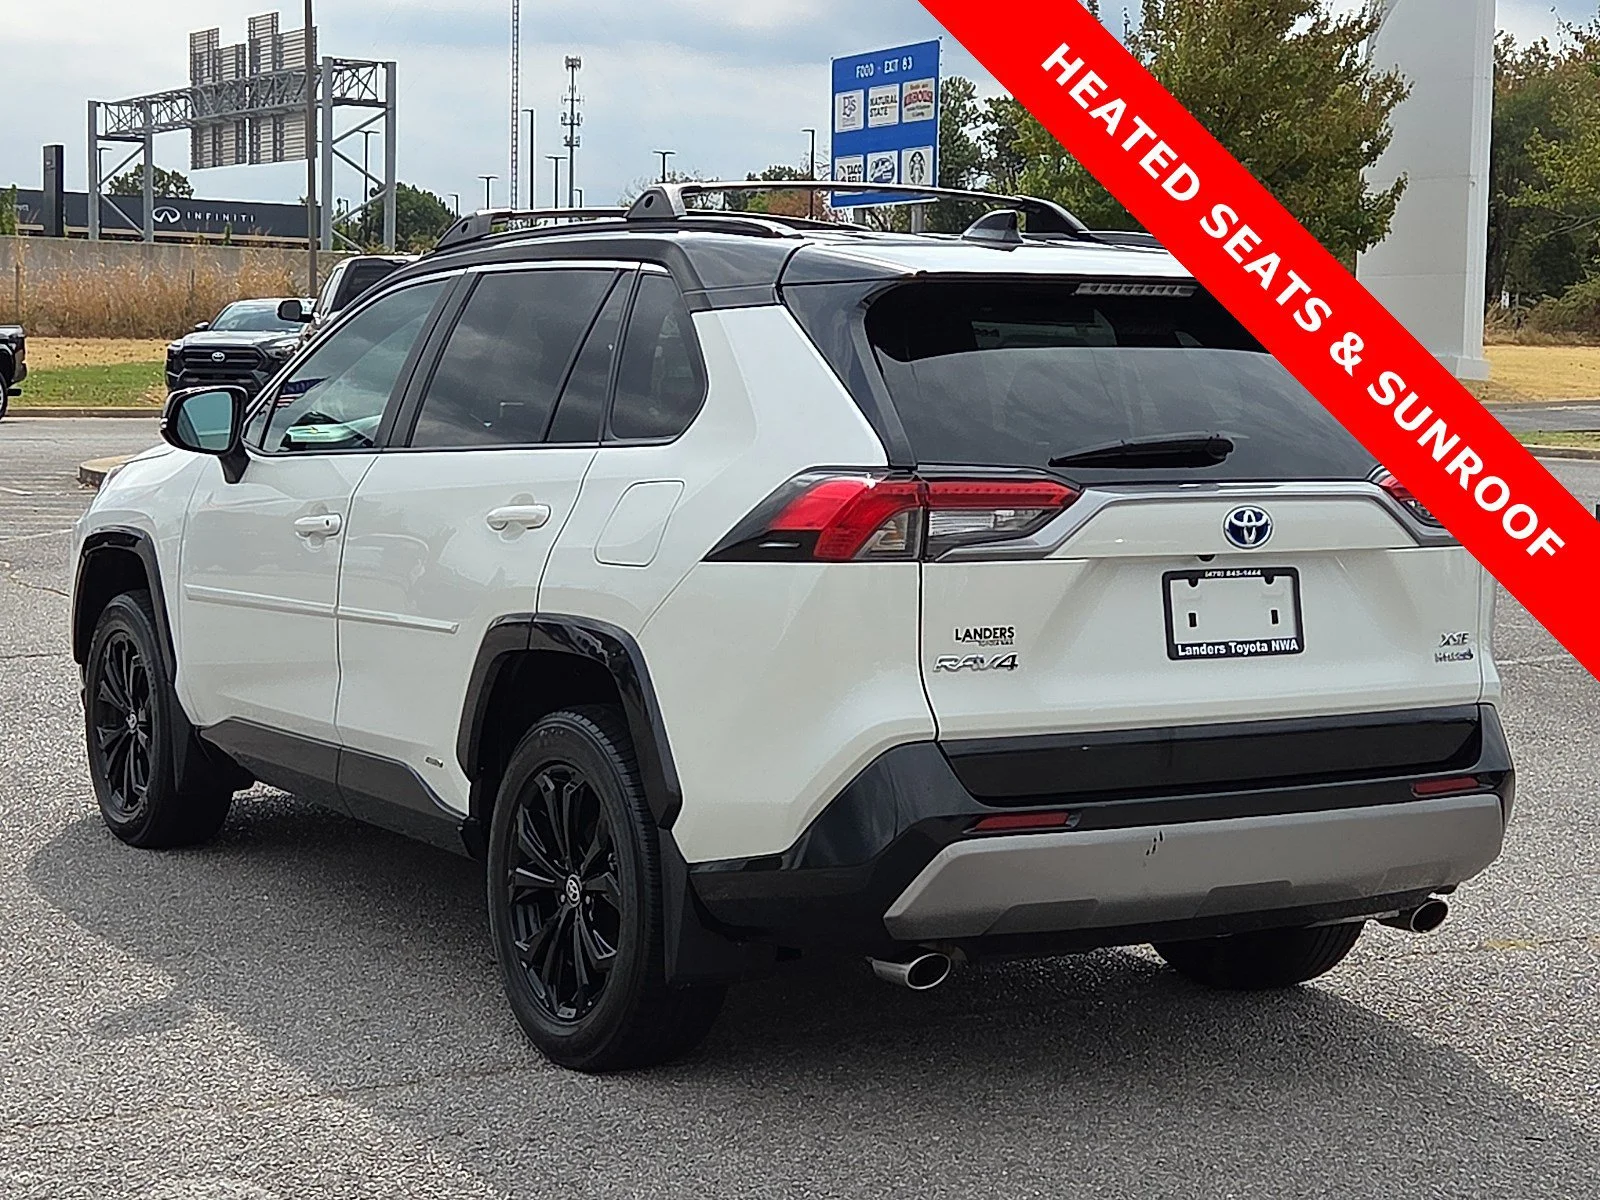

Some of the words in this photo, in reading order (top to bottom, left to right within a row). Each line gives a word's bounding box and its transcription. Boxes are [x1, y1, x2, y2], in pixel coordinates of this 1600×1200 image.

[855, 63, 874, 79] FOOD
[884, 59, 899, 74] EXIT
[870, 94, 898, 107] NATURAL
[869, 106, 888, 118] STATE
[186, 211, 255, 223] INFINITI
[954, 626, 1015, 643] LANDERS
[1177, 644, 1227, 657] Landers
[1229, 641, 1269, 656] Toyota
[1271, 638, 1300, 652] NWA
[932, 651, 1019, 673] RAV4
